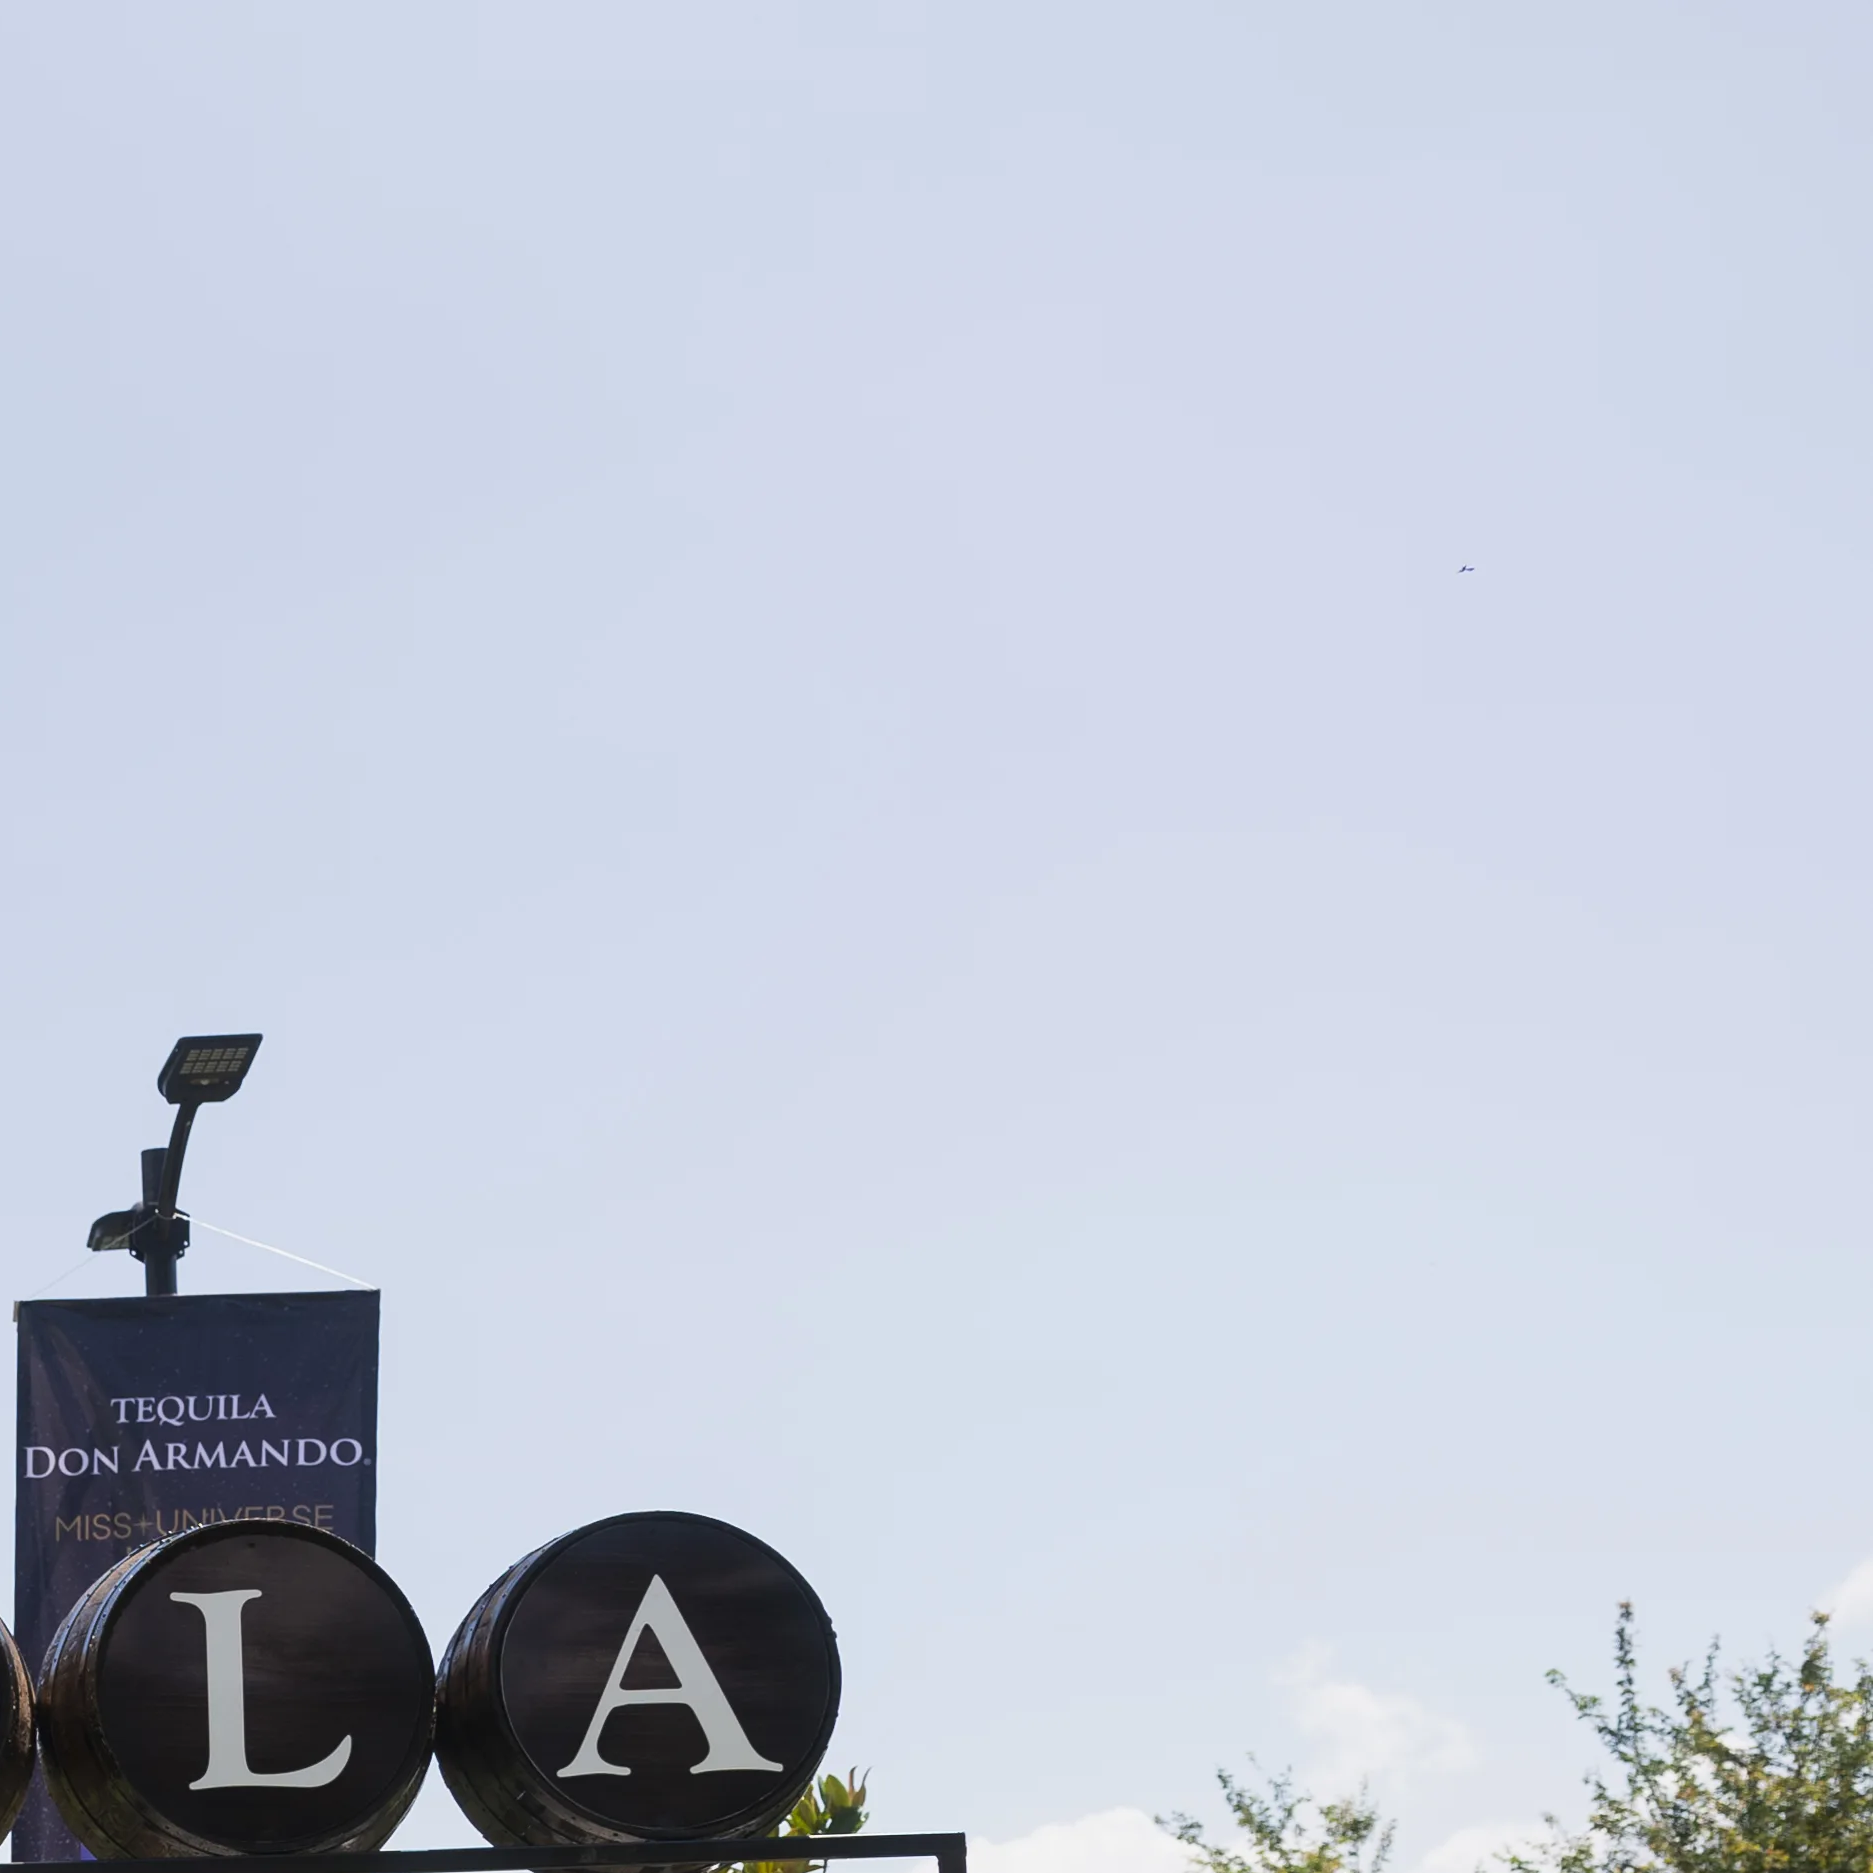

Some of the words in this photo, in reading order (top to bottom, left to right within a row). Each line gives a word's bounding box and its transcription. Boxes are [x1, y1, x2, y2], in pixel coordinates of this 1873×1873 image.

[110, 1393, 277, 1427] TEQUILA
[22, 1445, 120, 1479] DON
[55, 1512, 132, 1542] MISS
